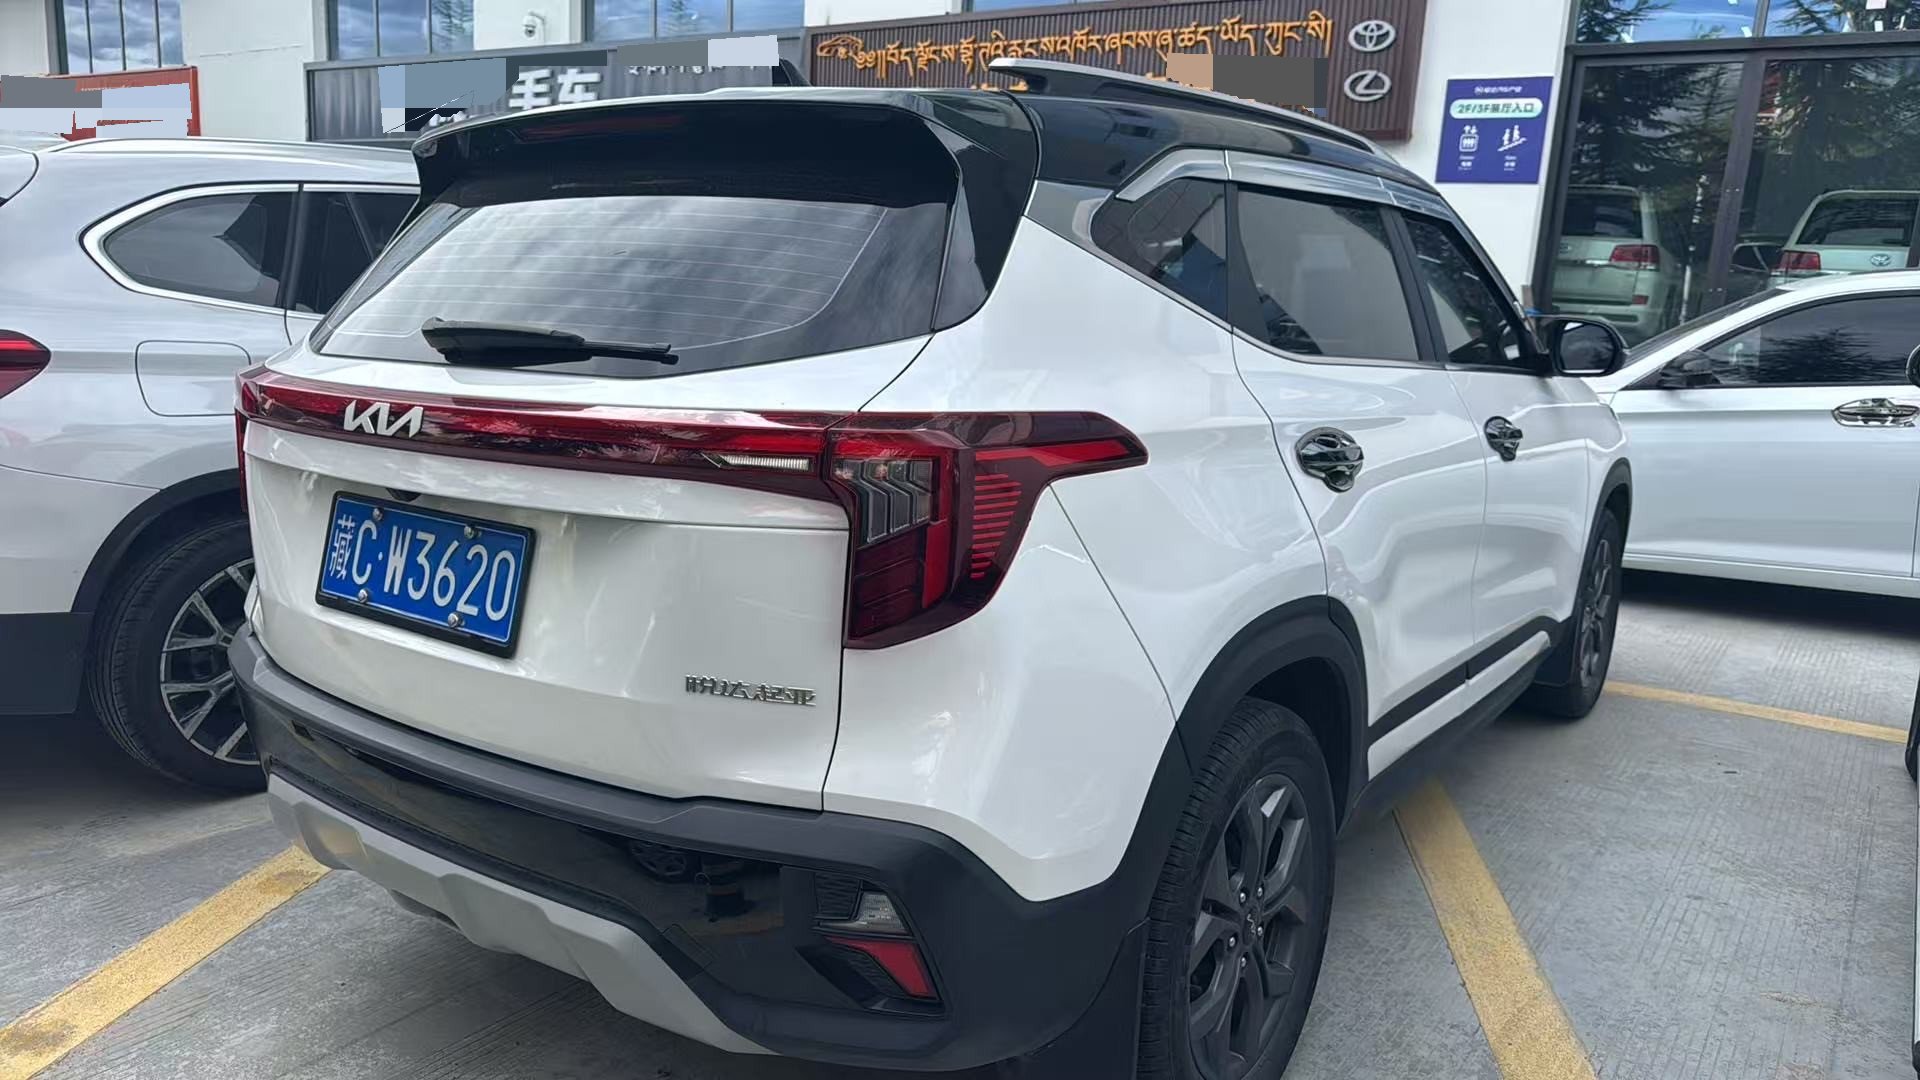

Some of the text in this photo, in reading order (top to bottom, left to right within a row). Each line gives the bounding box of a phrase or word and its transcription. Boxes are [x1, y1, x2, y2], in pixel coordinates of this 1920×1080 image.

[1458, 103, 1534, 114] 2F/3F展厅入口
[343, 400, 424, 438] KIA
[685, 674, 816, 706] 悦达起亚
